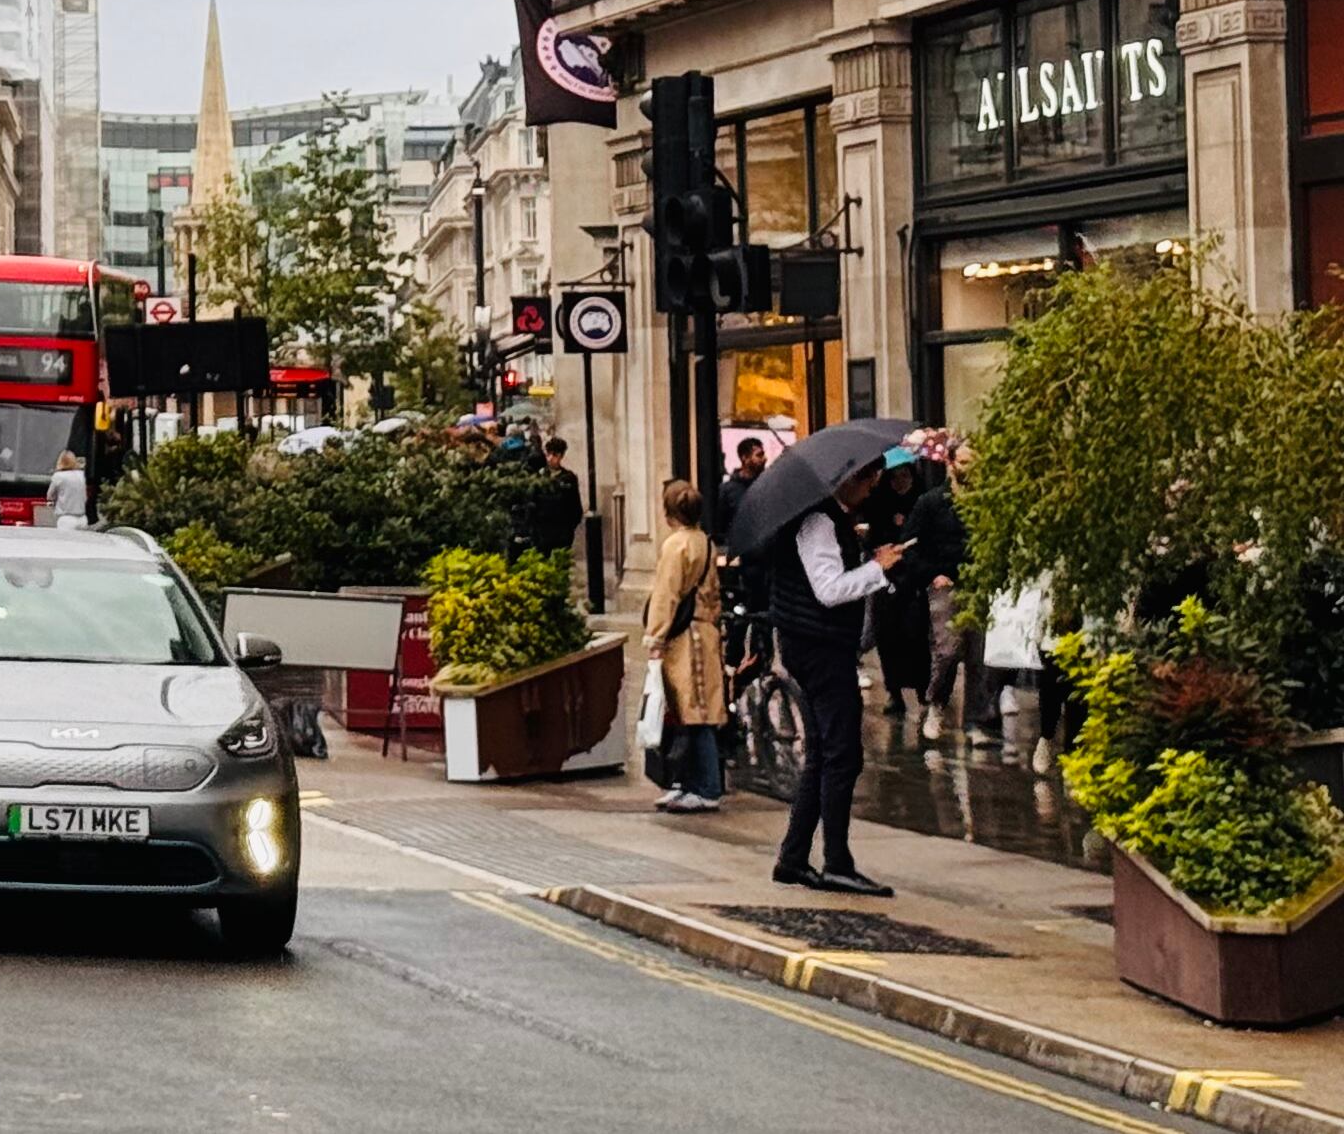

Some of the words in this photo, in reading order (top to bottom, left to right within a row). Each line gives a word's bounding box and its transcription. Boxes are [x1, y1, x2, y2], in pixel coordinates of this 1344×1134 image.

[41, 353, 65, 373] 94
[29, 807, 83, 831] LS71
[92, 809, 141, 832] MKE
